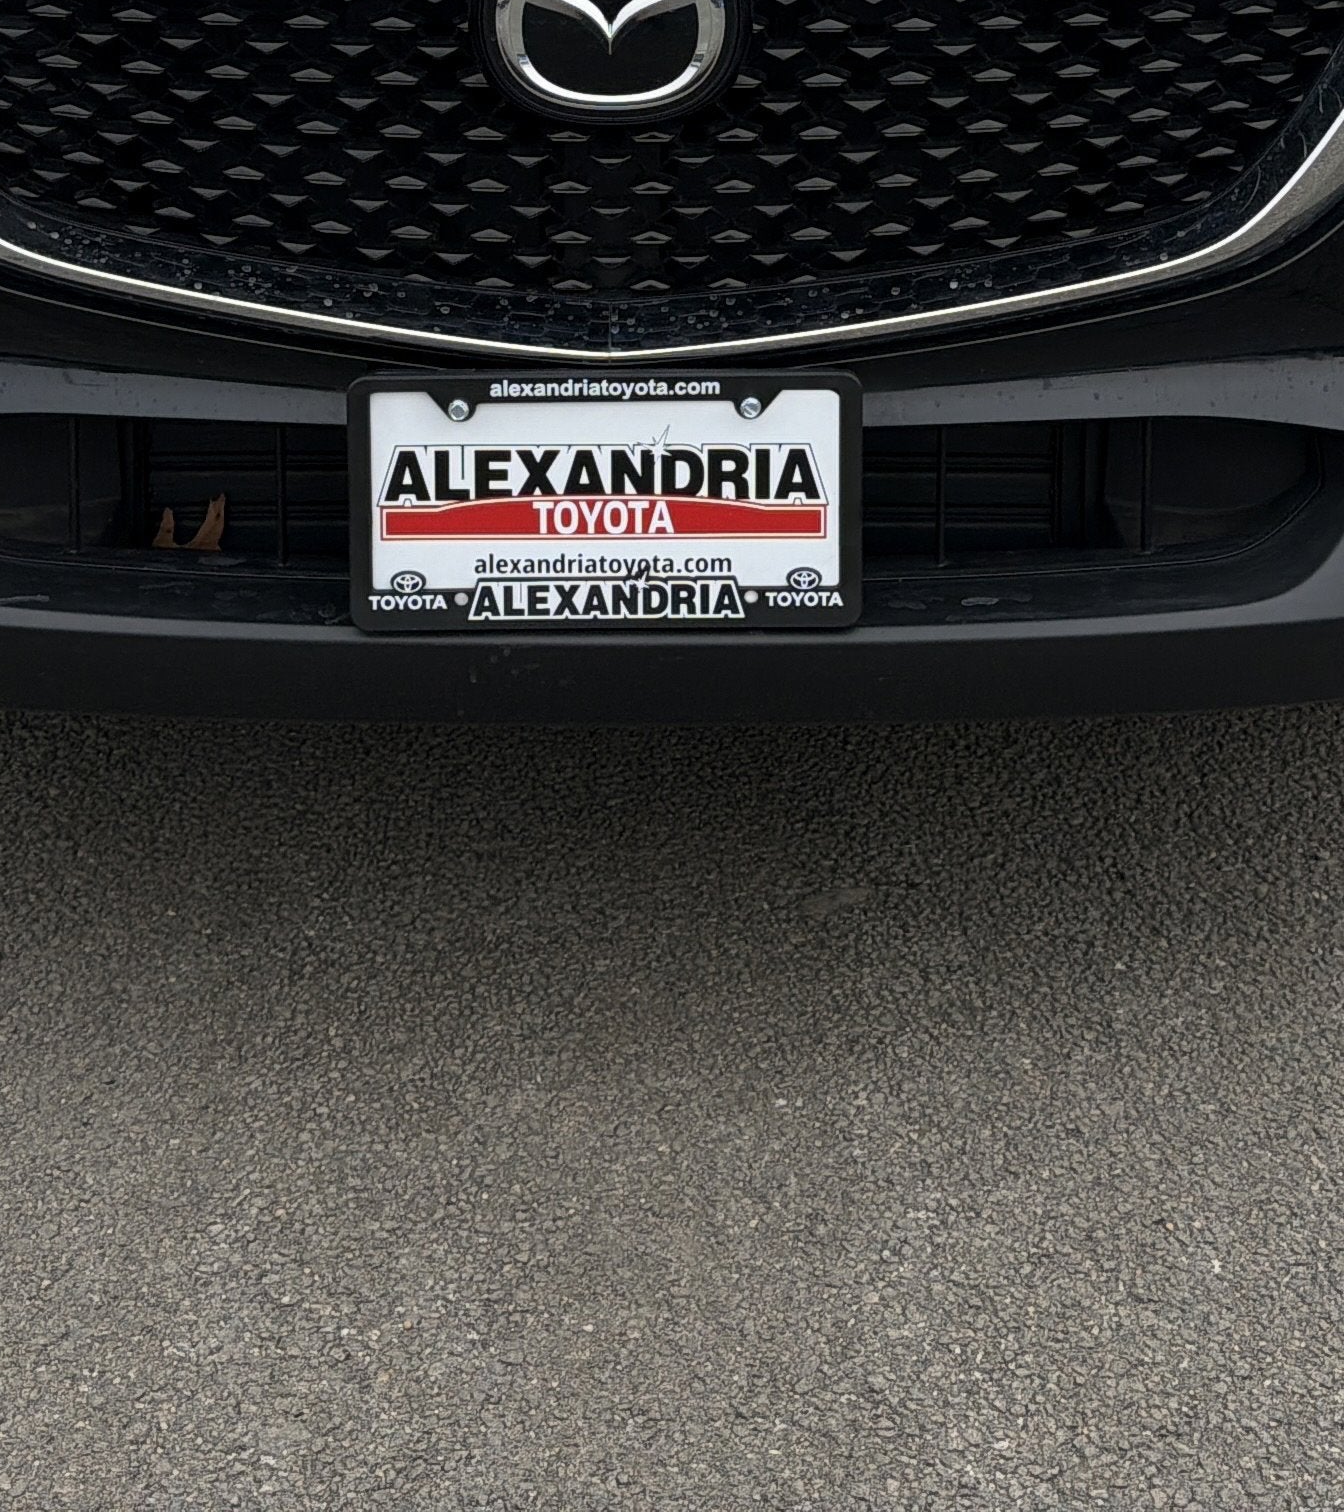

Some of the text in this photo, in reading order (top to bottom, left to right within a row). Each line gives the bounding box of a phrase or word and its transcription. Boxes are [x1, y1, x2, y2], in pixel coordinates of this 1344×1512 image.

[489, 378, 721, 400] alexandriatoyota.com
[383, 447, 823, 503] ALEXANDRIA
[532, 499, 675, 535] TOYOTA
[474, 553, 733, 577] alexandriatoyota.com
[369, 594, 448, 612] TOYOTA
[469, 579, 744, 620] ALEXANDRIA
[765, 591, 844, 609] TOYOTA
